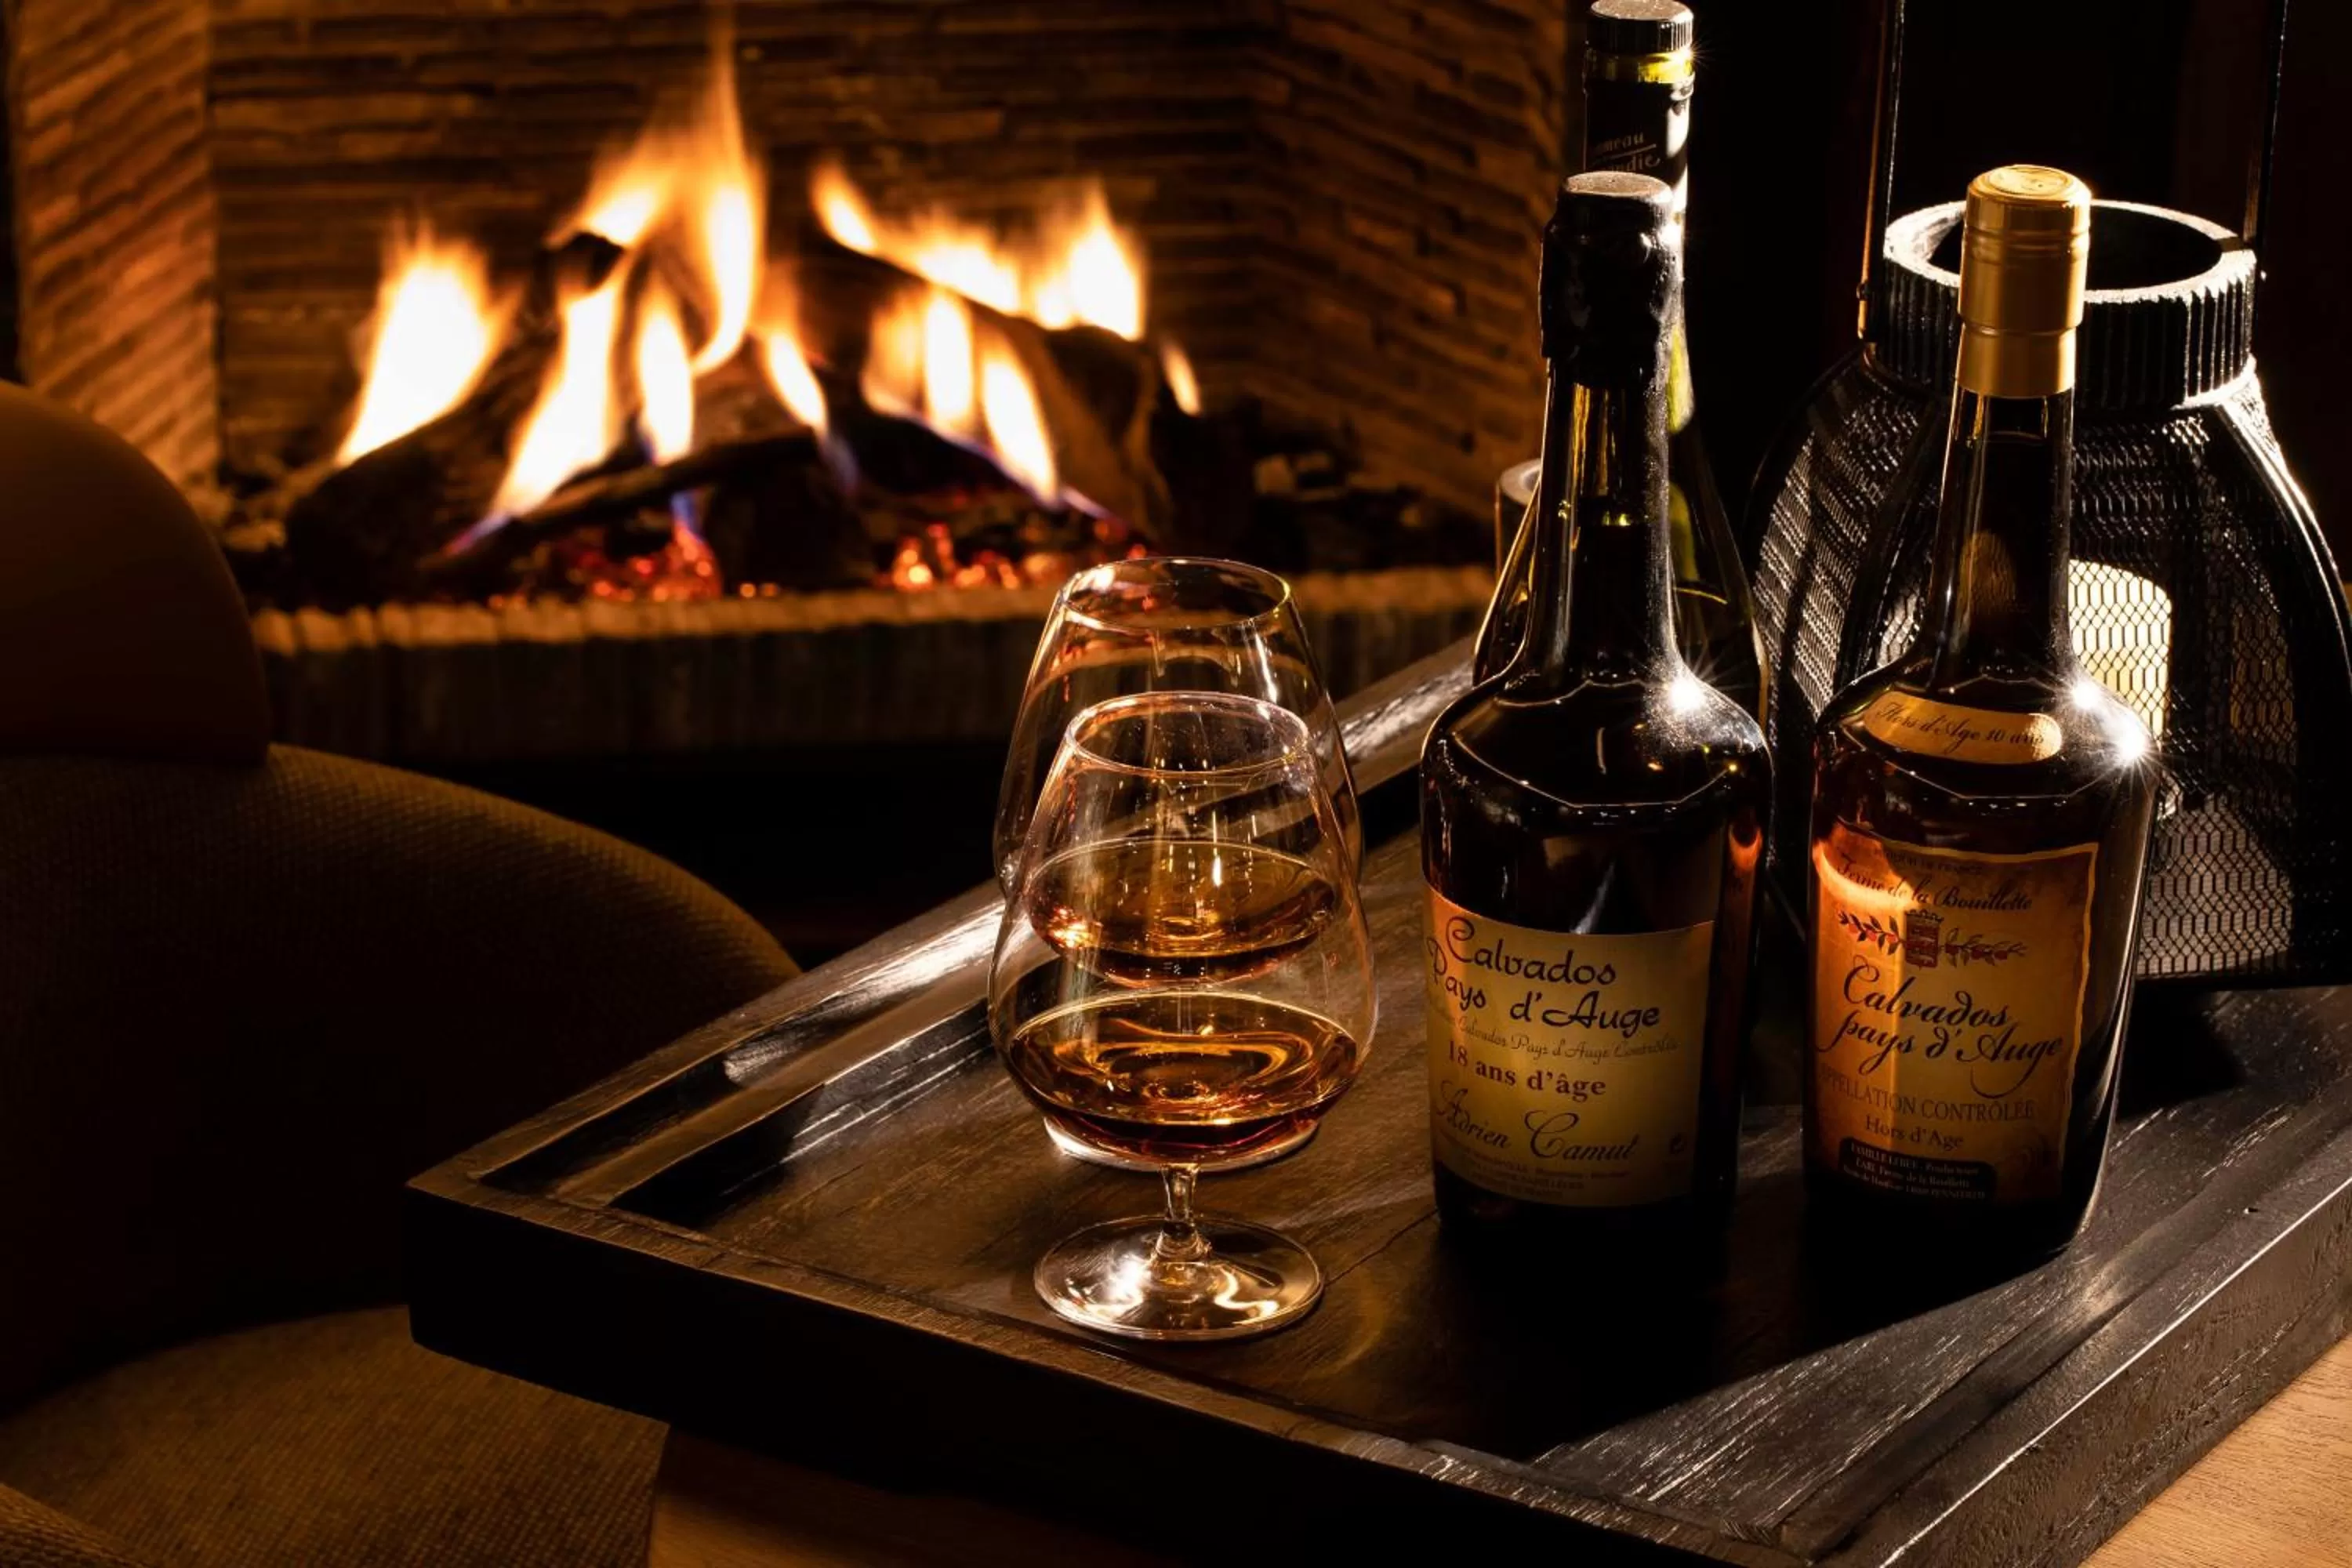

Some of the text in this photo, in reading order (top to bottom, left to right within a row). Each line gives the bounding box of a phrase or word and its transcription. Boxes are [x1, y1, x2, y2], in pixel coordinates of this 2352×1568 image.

[1446, 916, 1617, 985] Calvados
[1427, 937, 1486, 1012] Pays
[1509, 989, 1661, 1039] d'Auge
[1844, 954, 2010, 1029] Calvados
[1448, 1040, 1606, 1104] 18 ans d'âge
[1925, 1022, 2064, 1098] d'Auge
[1436, 1080, 1512, 1150] Adrien
[1865, 1113, 1904, 1141] Hors
